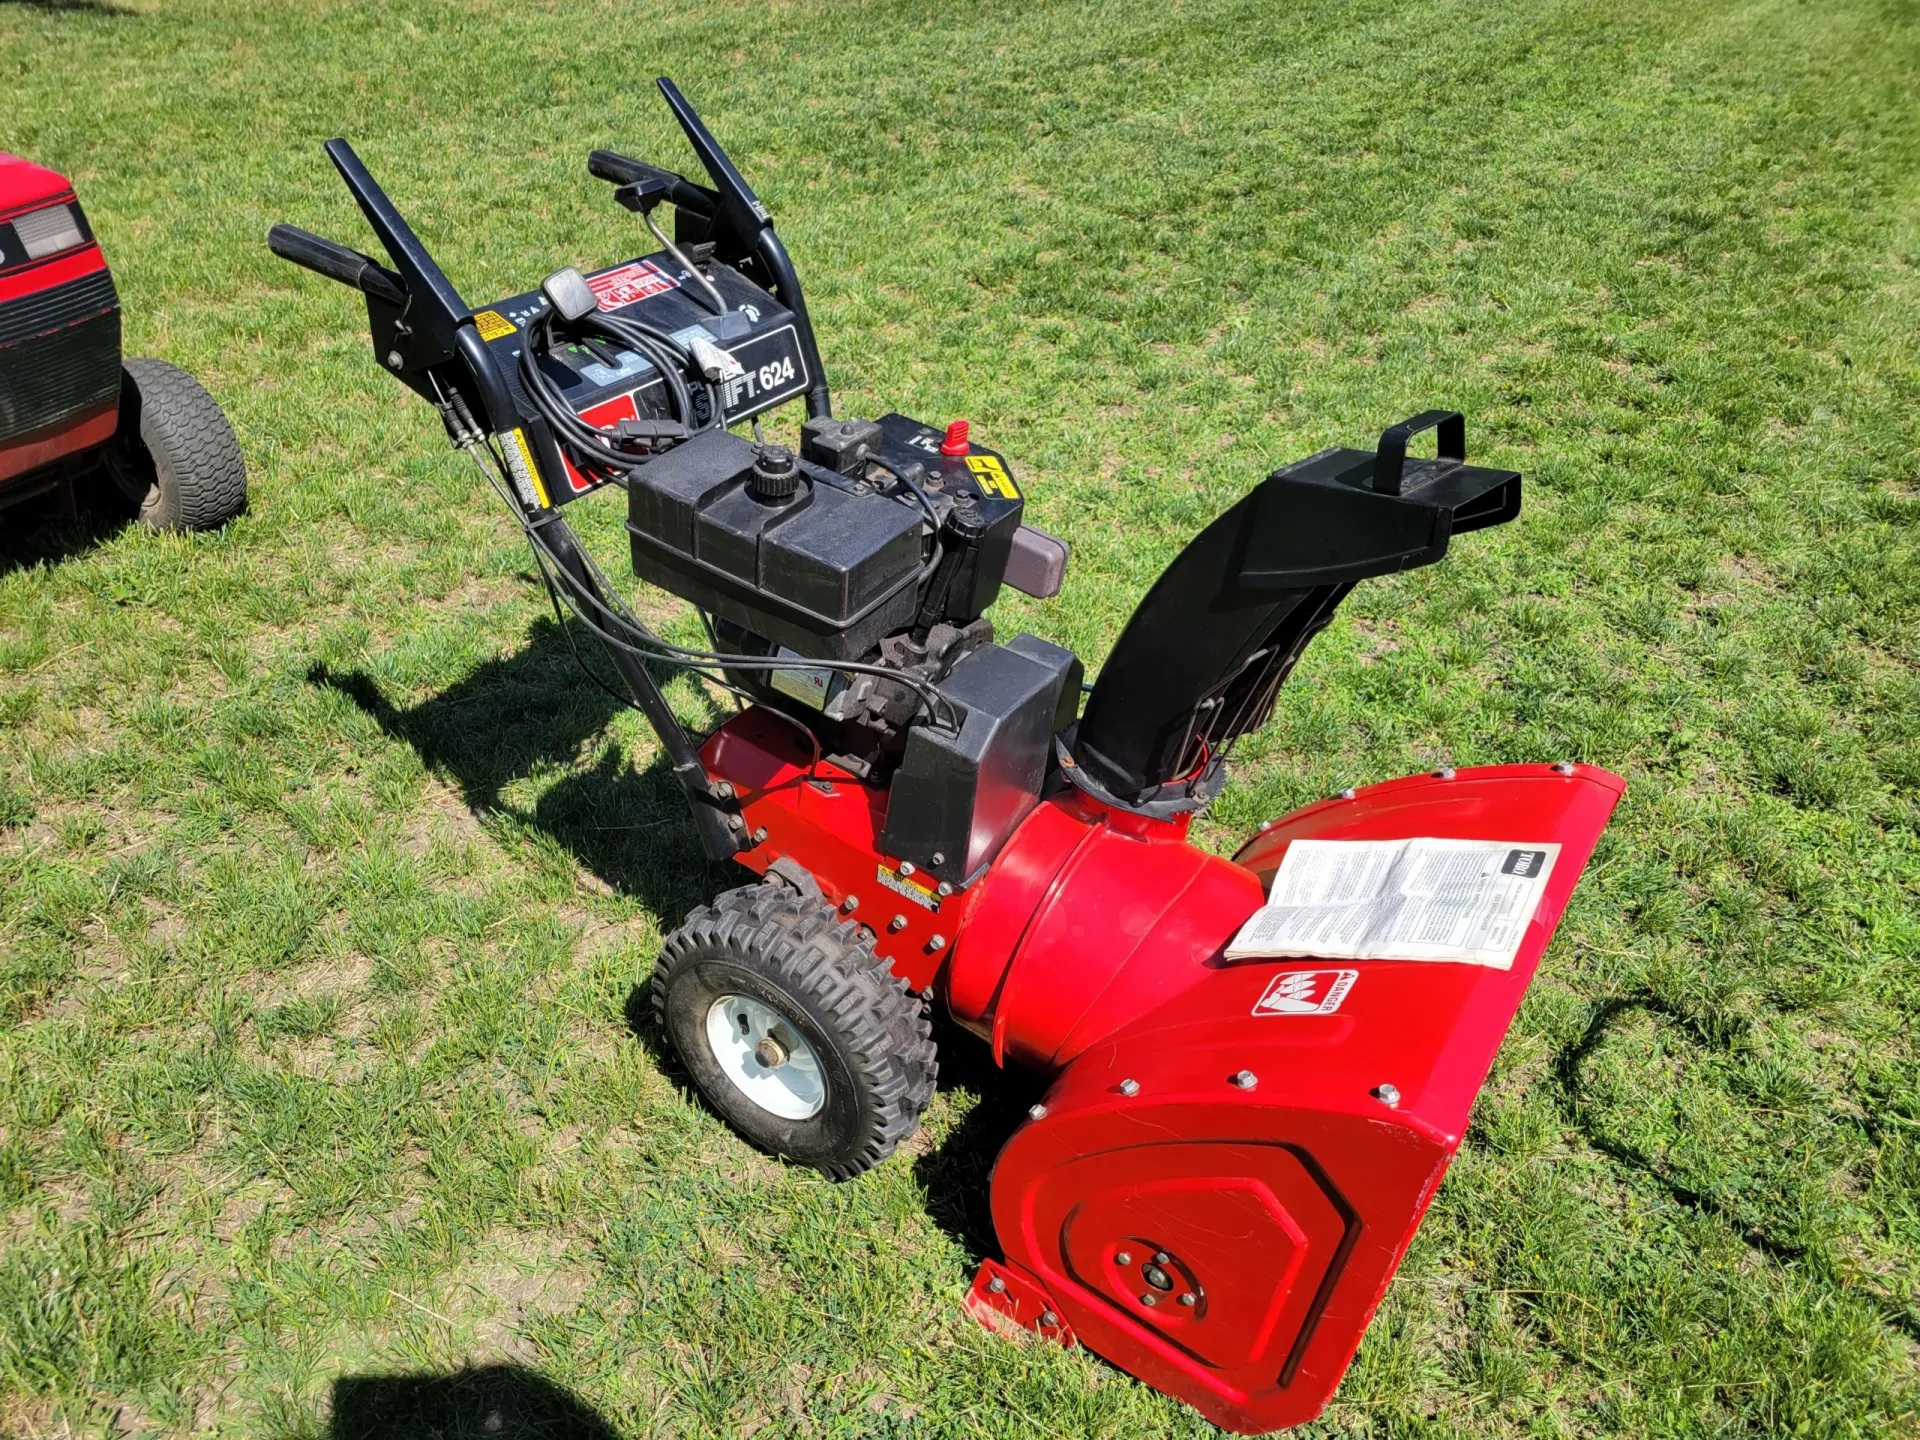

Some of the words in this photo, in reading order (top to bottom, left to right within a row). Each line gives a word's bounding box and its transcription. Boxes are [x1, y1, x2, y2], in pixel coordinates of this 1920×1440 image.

[760, 356, 795, 391] 624
[519, 441, 537, 480] WARNING
[1512, 852, 1536, 876] TORO
[1321, 981, 1348, 1011] DANGER
